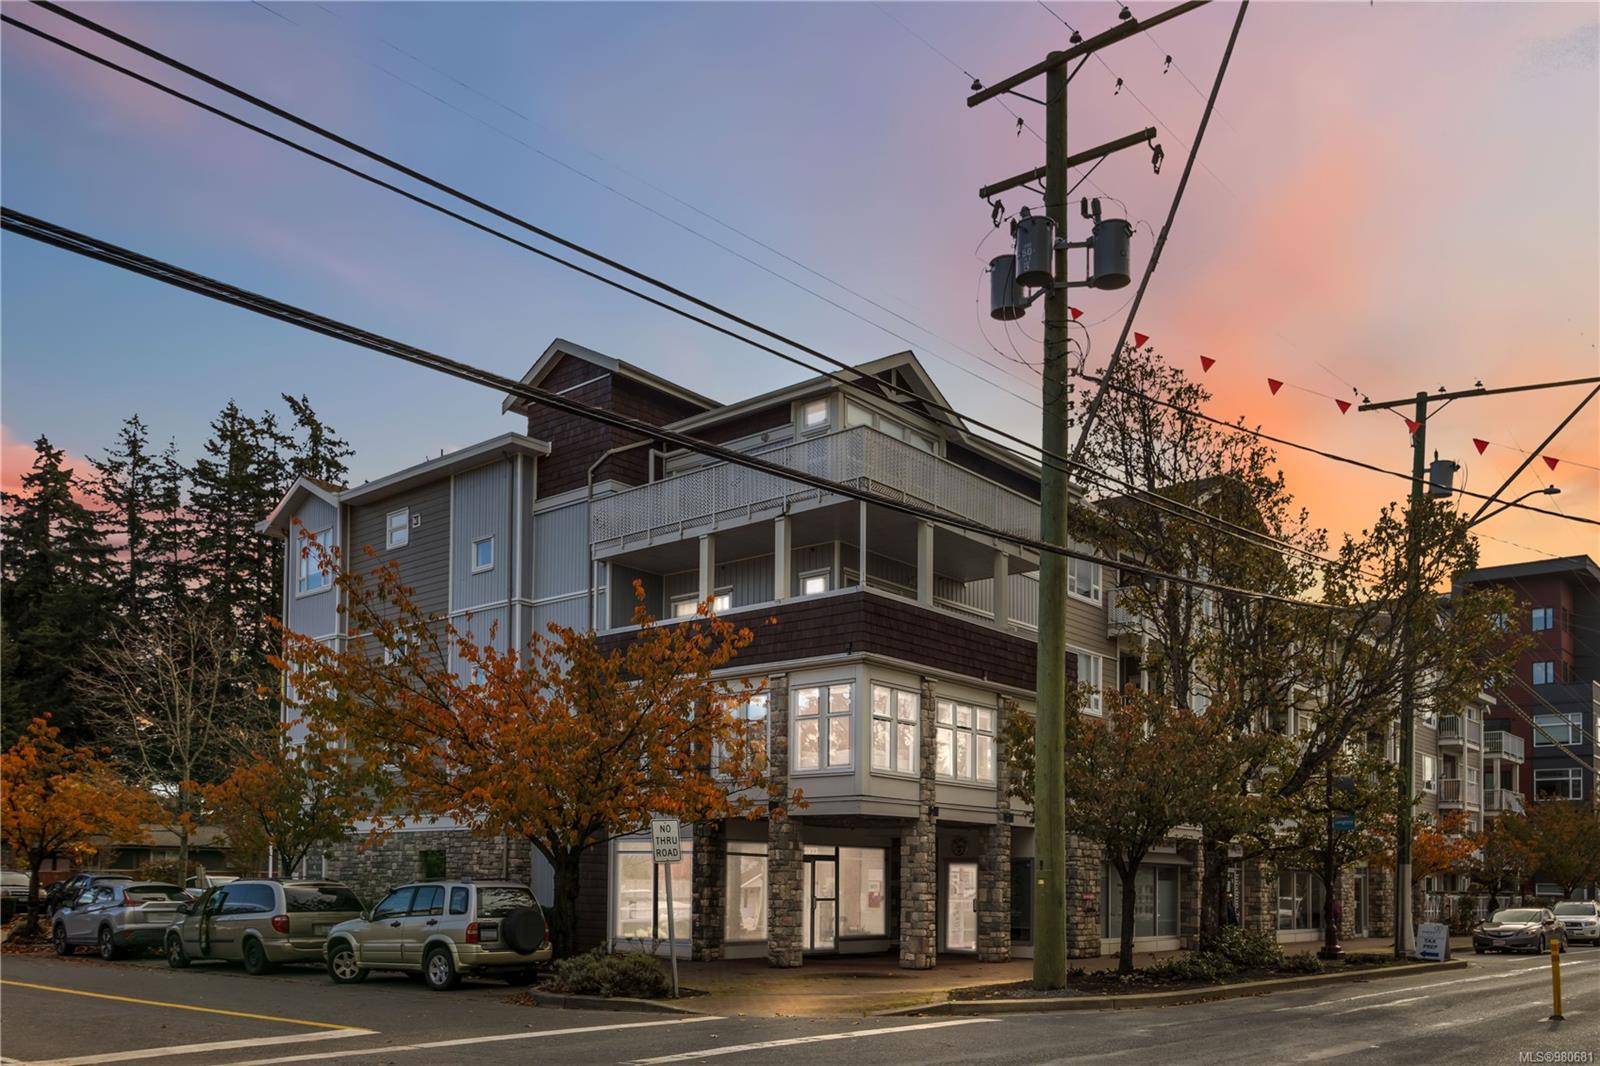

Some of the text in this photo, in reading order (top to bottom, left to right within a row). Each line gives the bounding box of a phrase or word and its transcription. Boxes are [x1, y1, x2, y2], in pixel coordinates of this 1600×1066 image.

[659, 824, 671, 833] NO
[655, 836, 678, 845] THRU
[656, 848, 678, 857] ROAD
